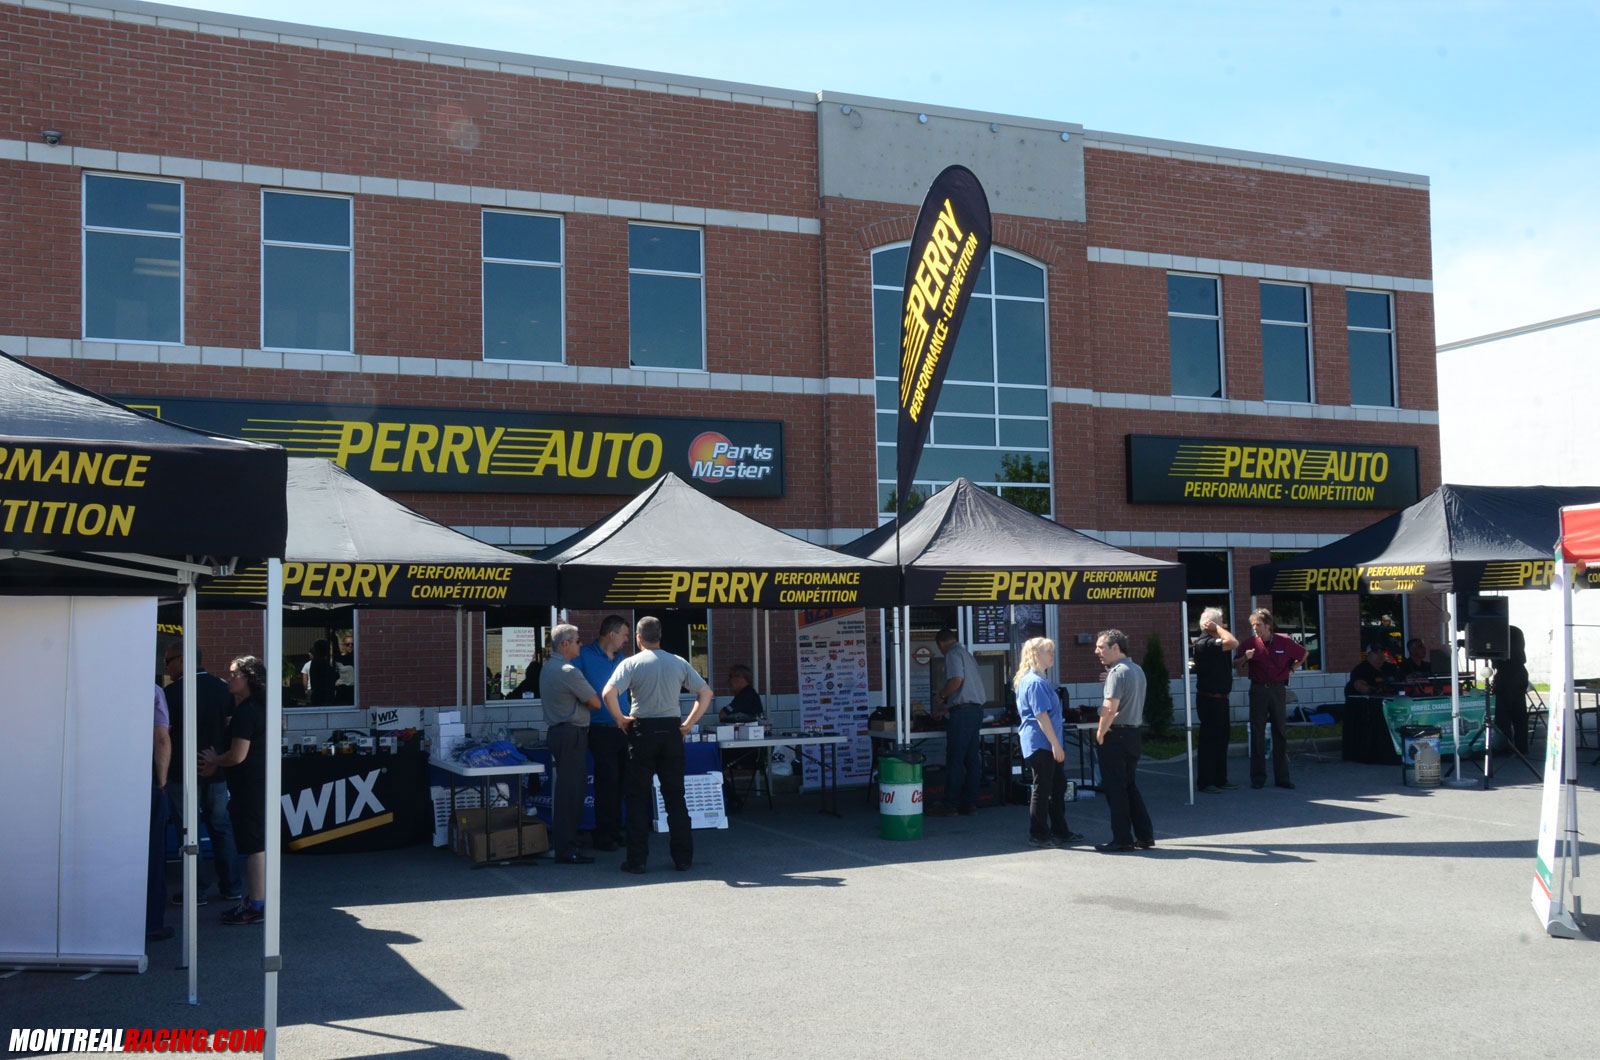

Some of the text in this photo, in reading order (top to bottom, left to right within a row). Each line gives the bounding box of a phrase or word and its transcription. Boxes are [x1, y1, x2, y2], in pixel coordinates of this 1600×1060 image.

[907, 198, 964, 331] PERRY
[909, 231, 979, 423] PERFORMANCE COMPÉTITION
[337, 420, 662, 480] PERRY AUTO
[712, 441, 774, 461] Parts
[692, 460, 771, 480] Master
[1224, 445, 1389, 483] PERRY AUTO
[1184, 481, 1375, 502] PERFORMANCE COMPÉTITION
[282, 563, 400, 598] PERRY
[407, 566, 513, 581] PERFORMANCE
[774, 571, 860, 585] PERFORMANCE
[1082, 570, 1158, 583] PERFORMANCE
[1304, 566, 1365, 592] PERRY
[1366, 564, 1426, 578] PERFORMANCE
[411, 582, 508, 599] COMPÉTITION
[668, 571, 768, 604] PERRY
[779, 586, 858, 603] COMPÉTITION
[991, 571, 1078, 601] PERRY
[1086, 585, 1156, 600] COMPÉTITION
[1369, 577, 1424, 592] COTITI
[377, 708, 399, 723] WIX
[281, 768, 386, 839] WIX
